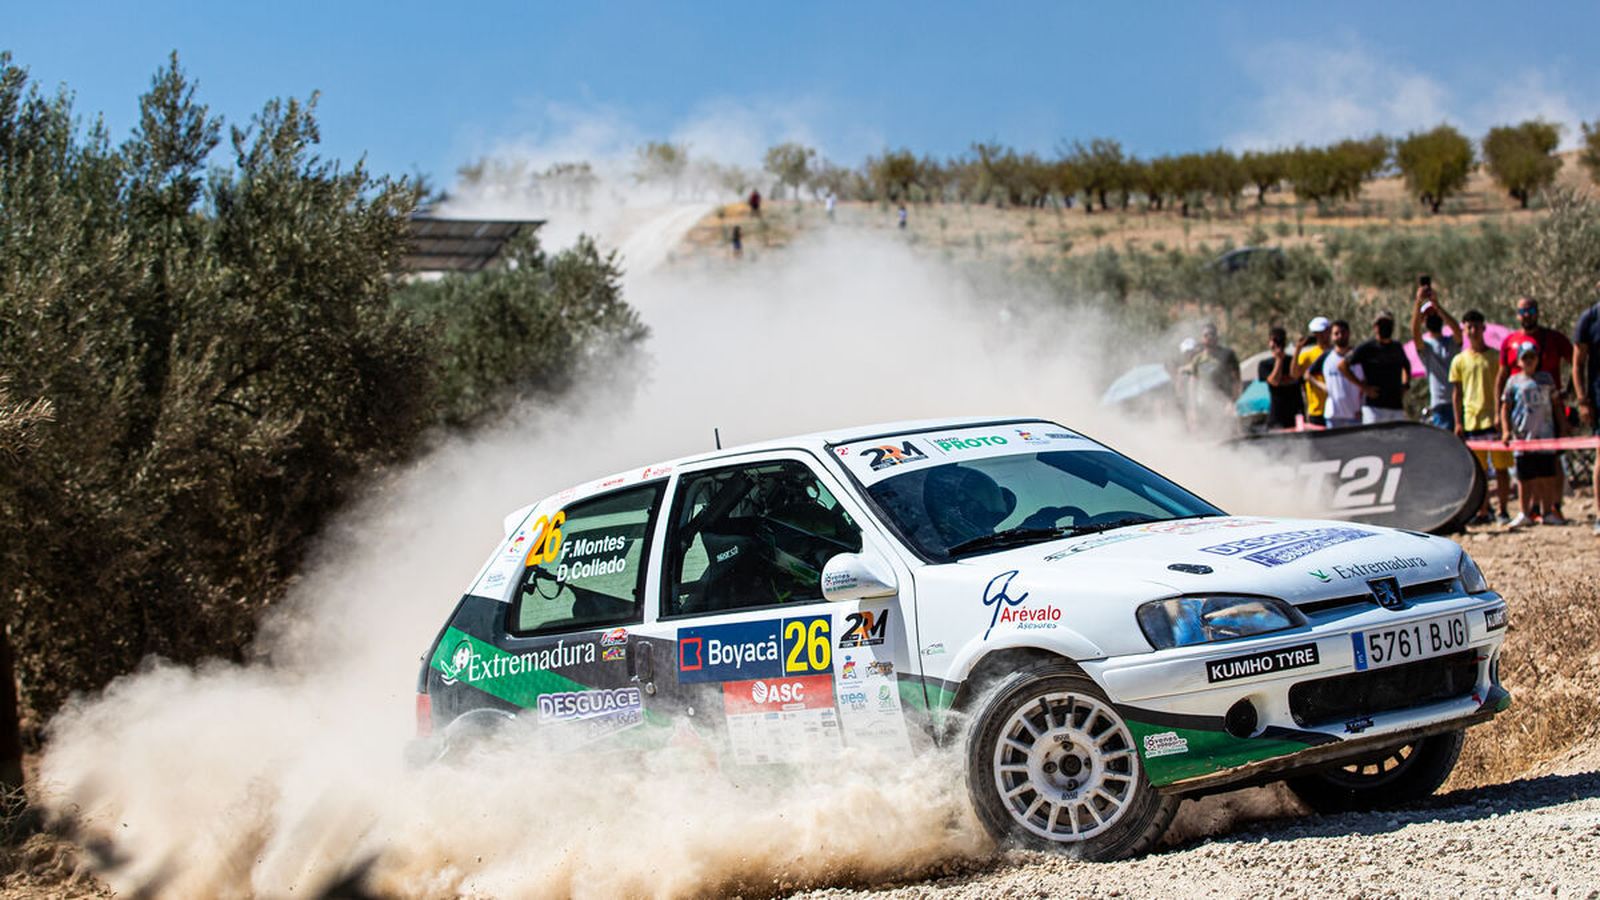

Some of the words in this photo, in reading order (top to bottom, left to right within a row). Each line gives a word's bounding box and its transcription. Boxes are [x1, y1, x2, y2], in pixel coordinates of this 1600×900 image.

[938, 435, 1008, 452] PROTO
[525, 510, 566, 567] 26
[560, 535, 626, 561] F.Montes
[556, 555, 627, 582] D.Collado
[1332, 556, 1428, 579] Extremadura
[1000, 605, 1062, 623] Arévalo
[708, 634, 778, 669] Boyacá
[784, 619, 832, 673] 26
[1369, 626, 1422, 663] 5761
[1429, 618, 1465, 652] BJG
[468, 639, 595, 682] Extremadura
[1211, 656, 1273, 680] KUMHO
[1276, 648, 1314, 668] TYRE
[540, 691, 640, 718] DESGUACE
[768, 682, 804, 703] ASC
